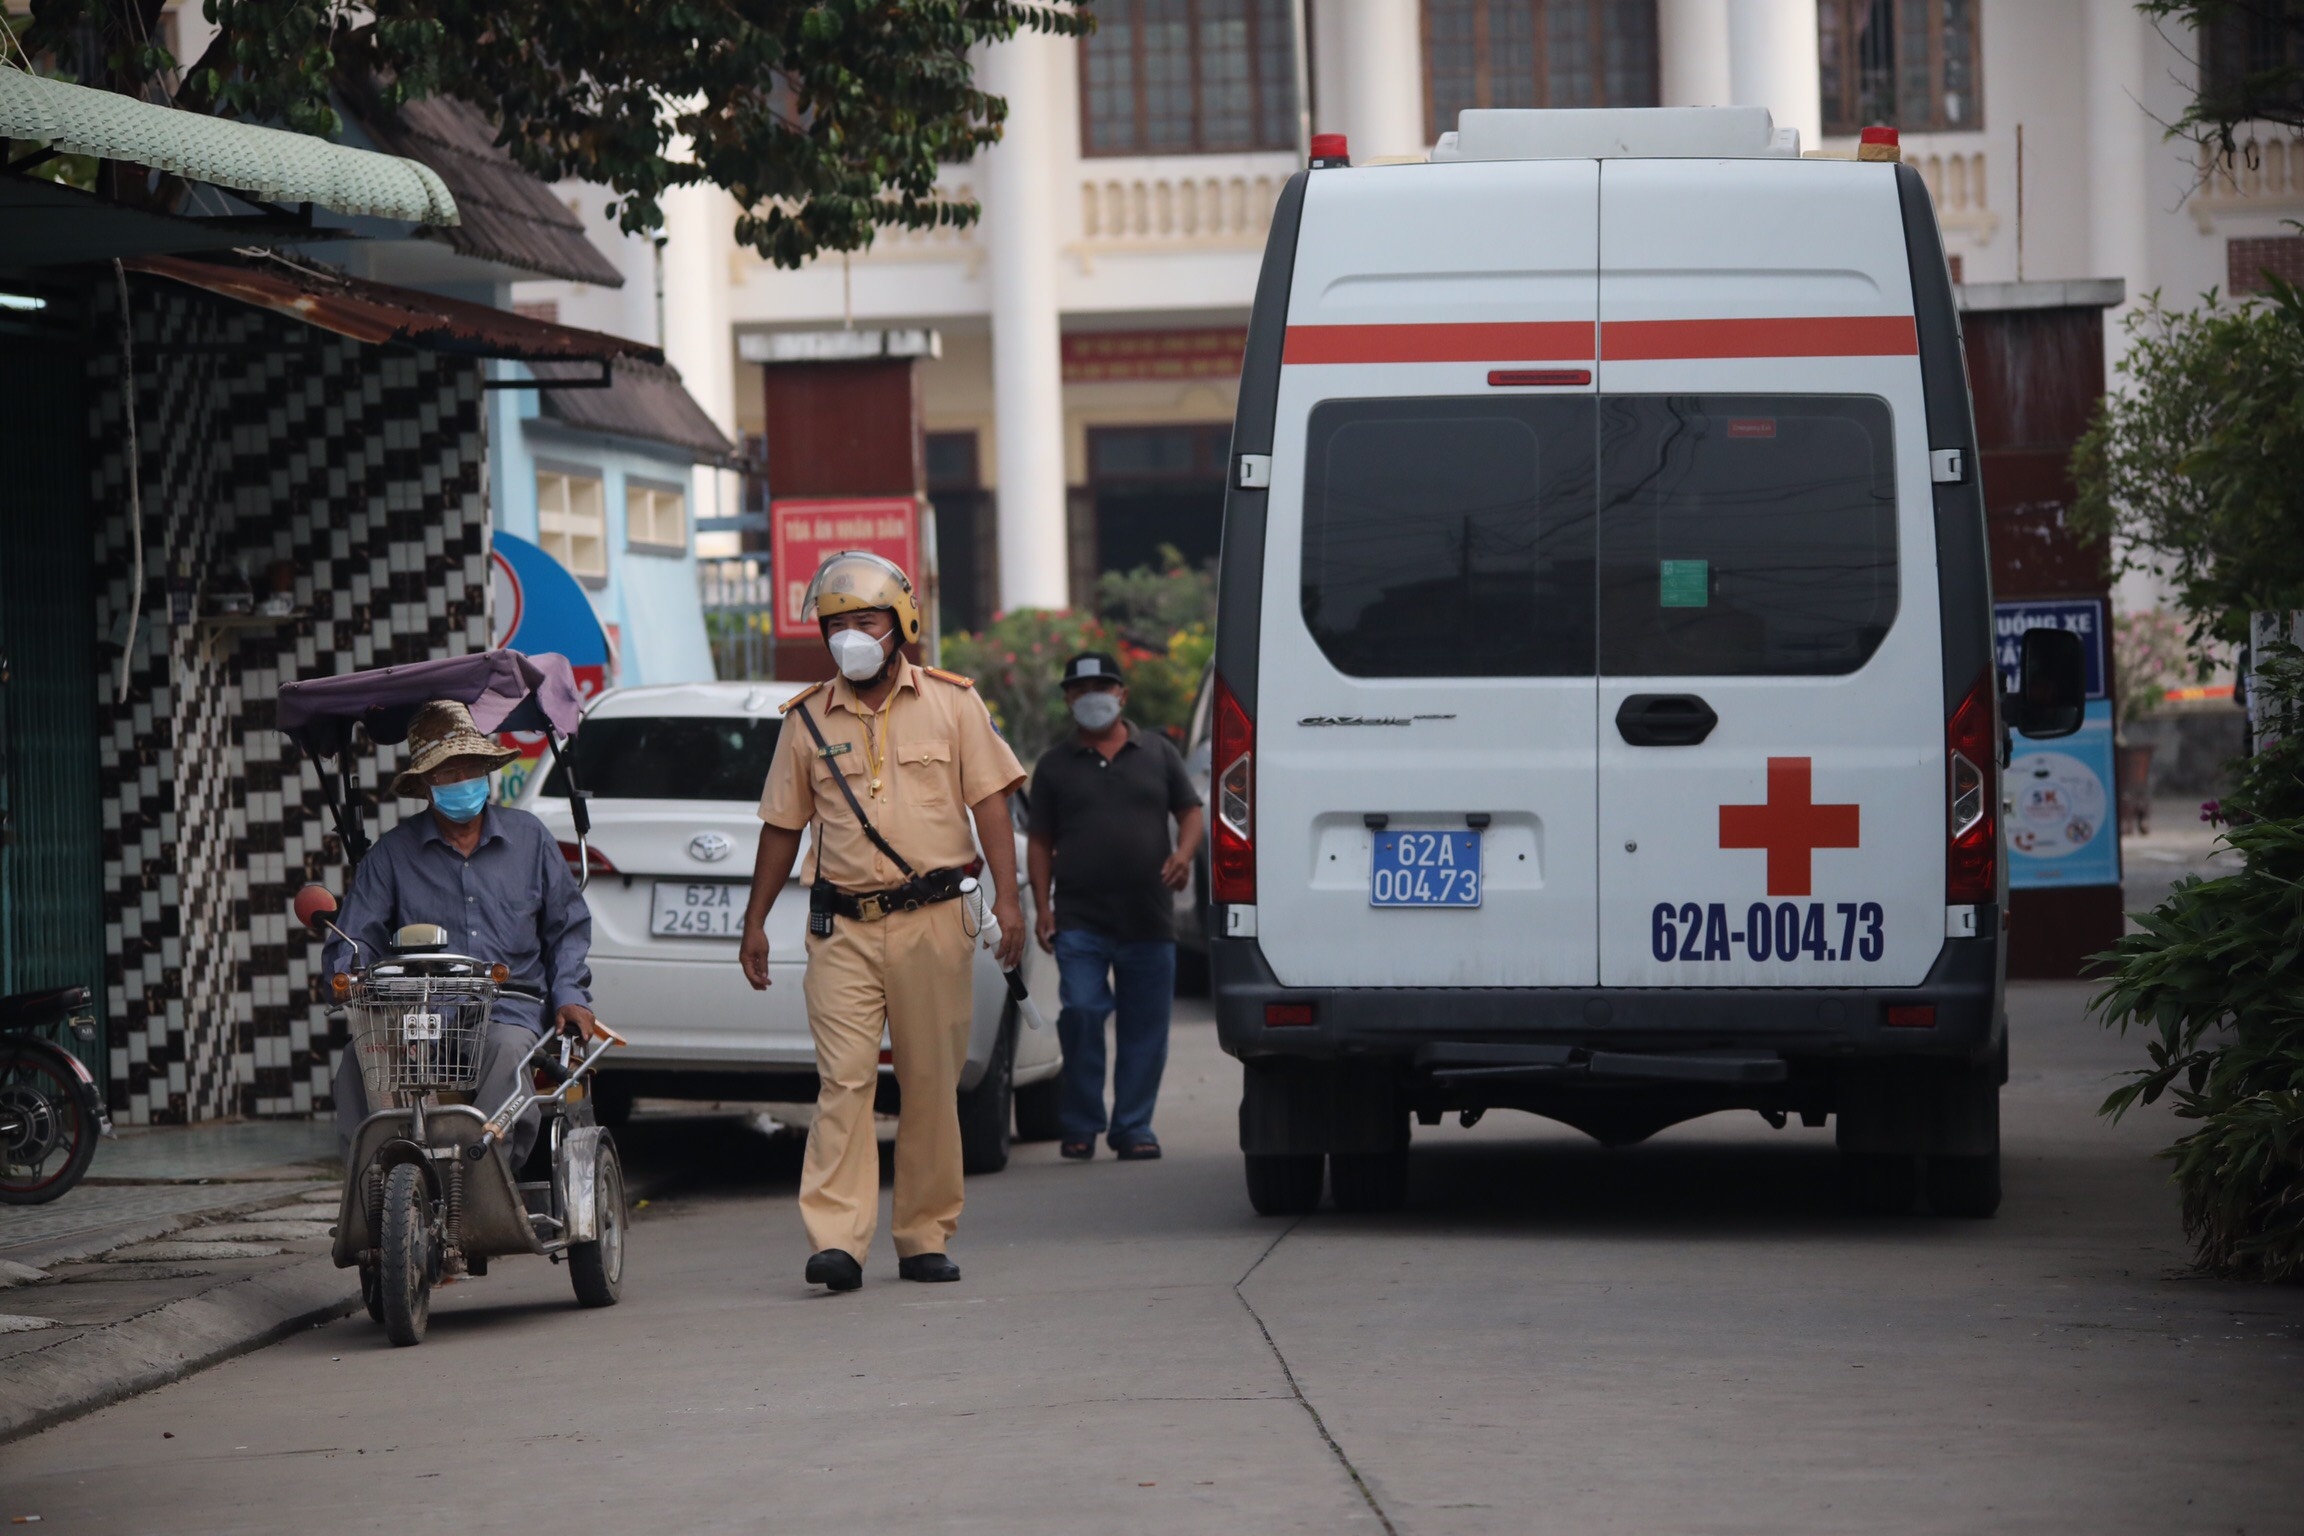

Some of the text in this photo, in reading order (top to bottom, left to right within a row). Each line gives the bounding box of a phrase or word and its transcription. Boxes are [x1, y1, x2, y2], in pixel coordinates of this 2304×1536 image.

[1398, 834, 1454, 866] 62A
[685, 885, 731, 907] 62A
[1375, 869, 1477, 901] 004.73
[1652, 902, 1884, 962] 62A-004.73
